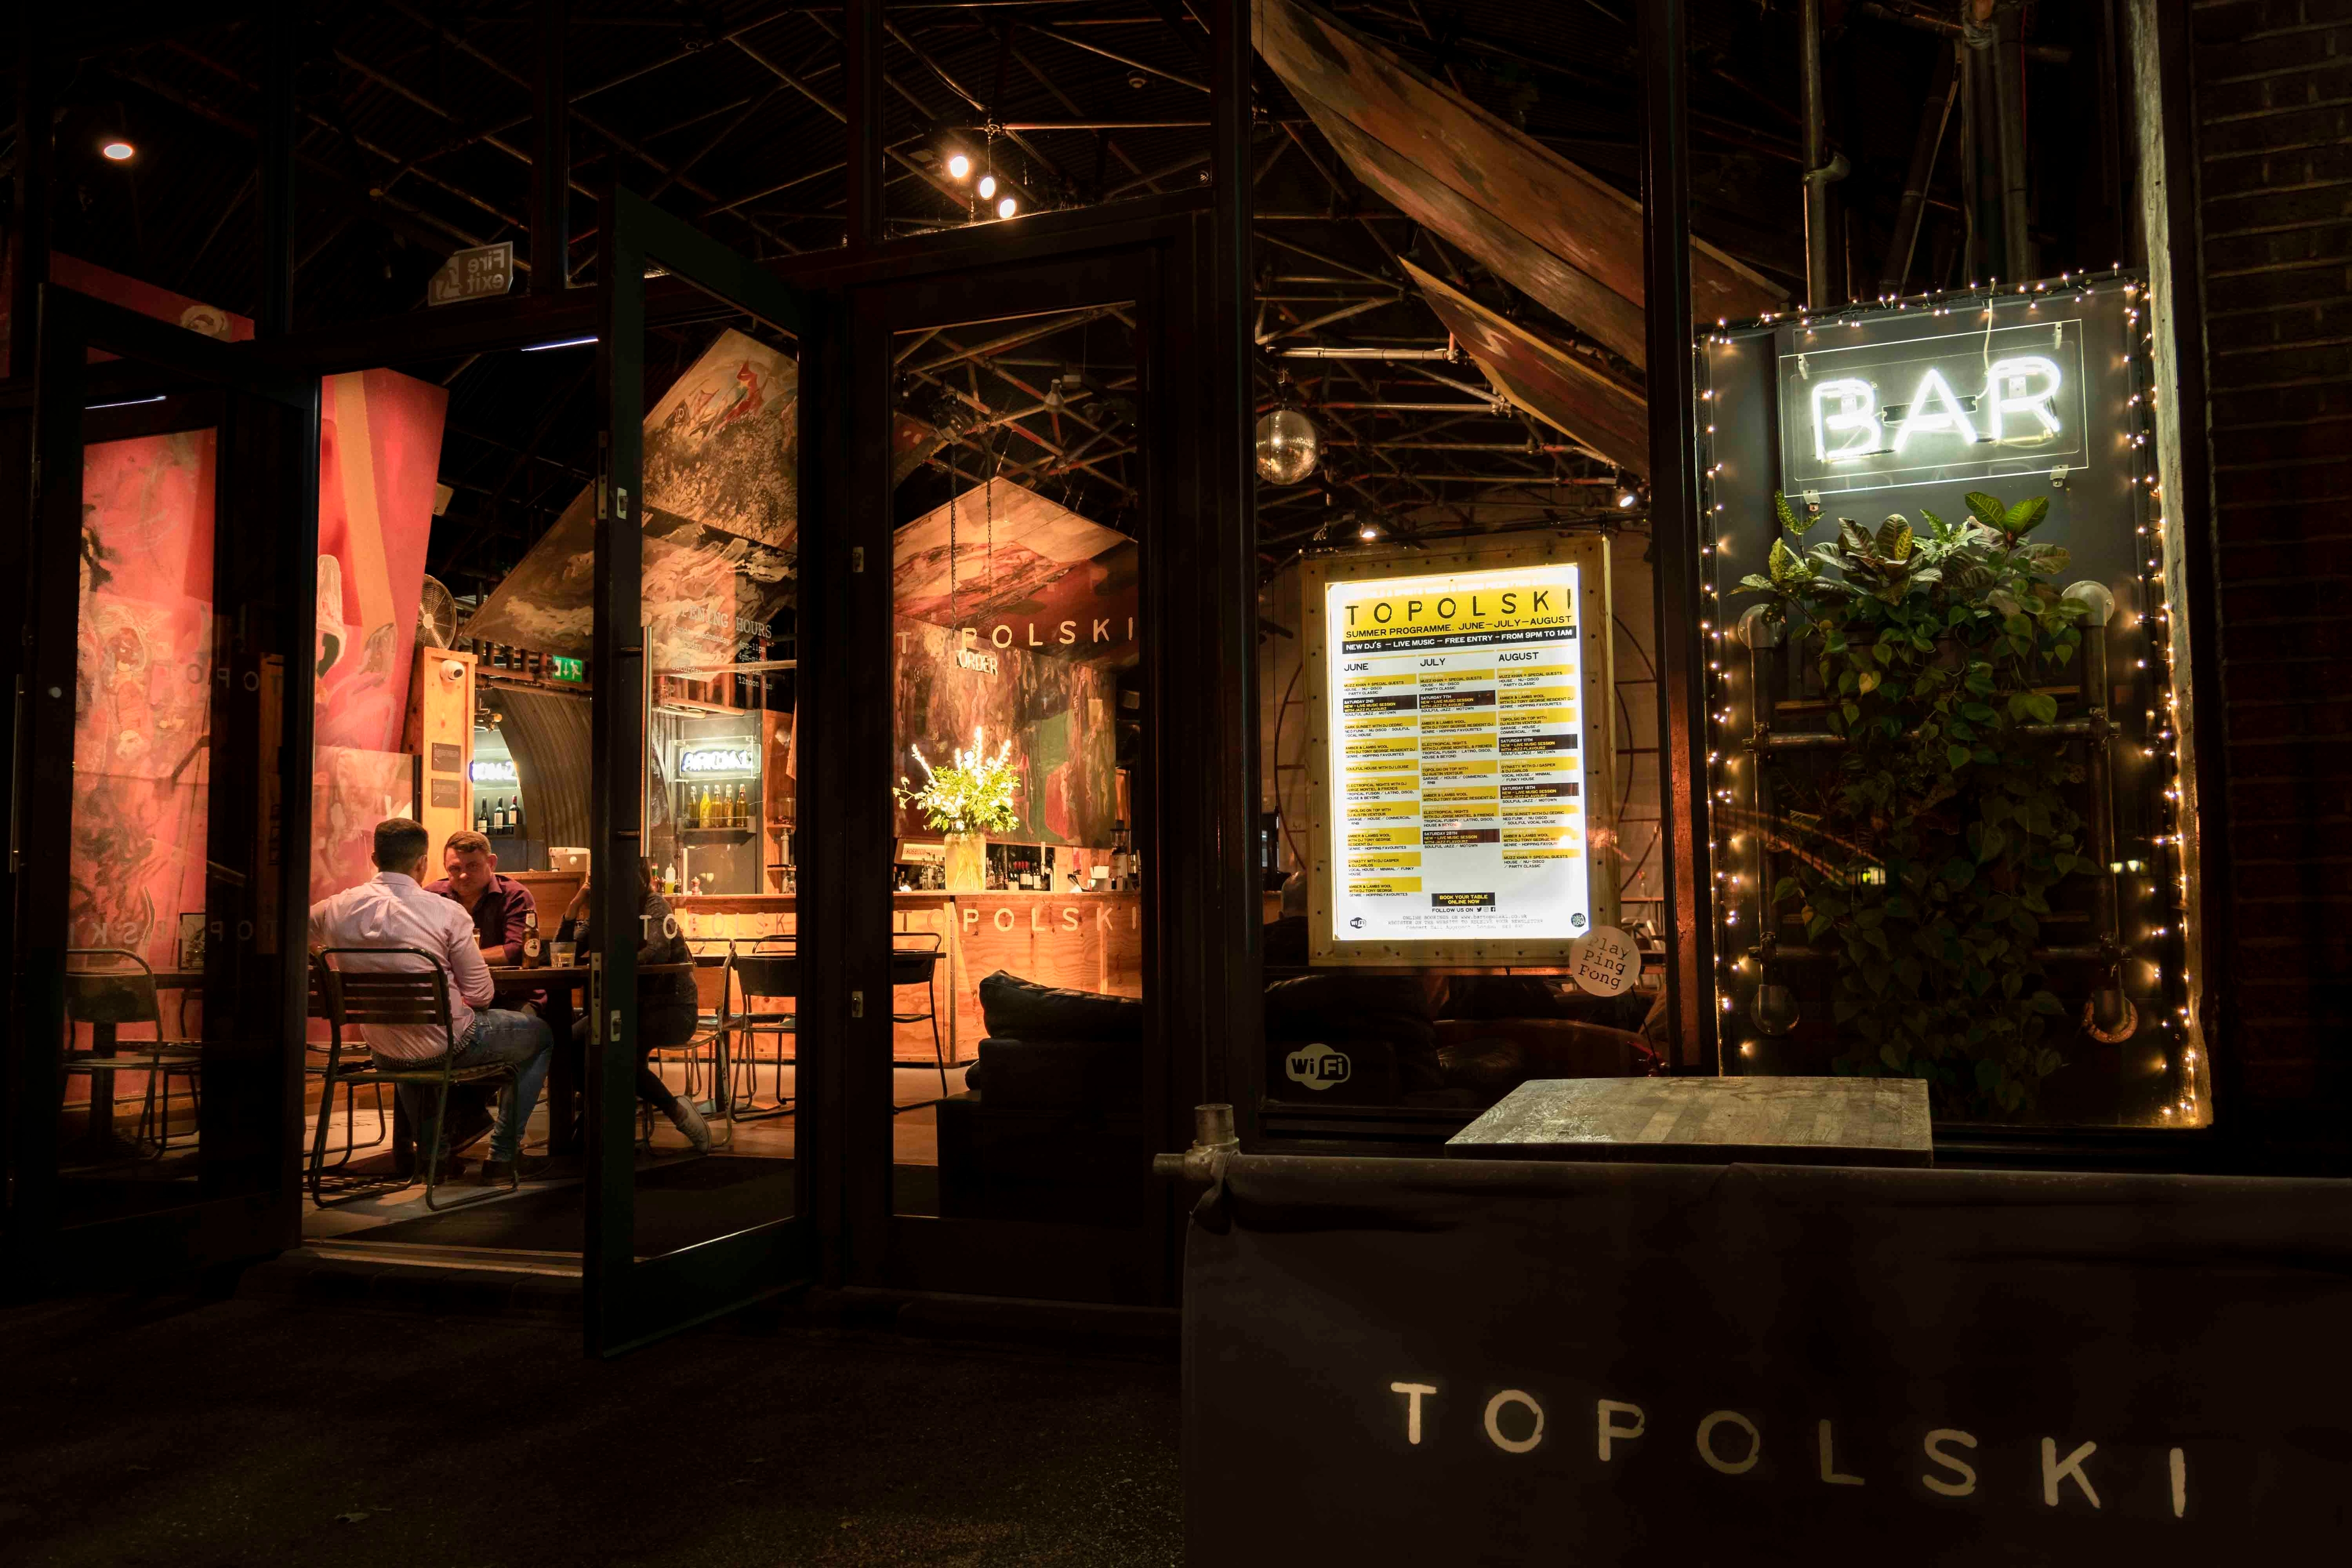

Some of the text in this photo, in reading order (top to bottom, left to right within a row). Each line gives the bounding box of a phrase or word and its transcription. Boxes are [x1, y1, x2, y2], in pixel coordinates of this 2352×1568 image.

[1811, 356, 2061, 461] BAR
[1344, 589, 1570, 625] TOPOLSKI
[674, 605, 772, 639] PENING HOURS
[1346, 629, 1386, 638] SUMMER
[959, 650, 998, 676] ORDER
[1420, 658, 1445, 666] JULY
[1499, 652, 1539, 662] AUGUST
[639, 913, 785, 940] TOOLSK
[897, 907, 1137, 932] TOPOLSKI
[1588, 935, 1630, 960] Play
[1583, 950, 1626, 975] Ping
[1390, 1380, 2185, 1519] TOPOLSKI
